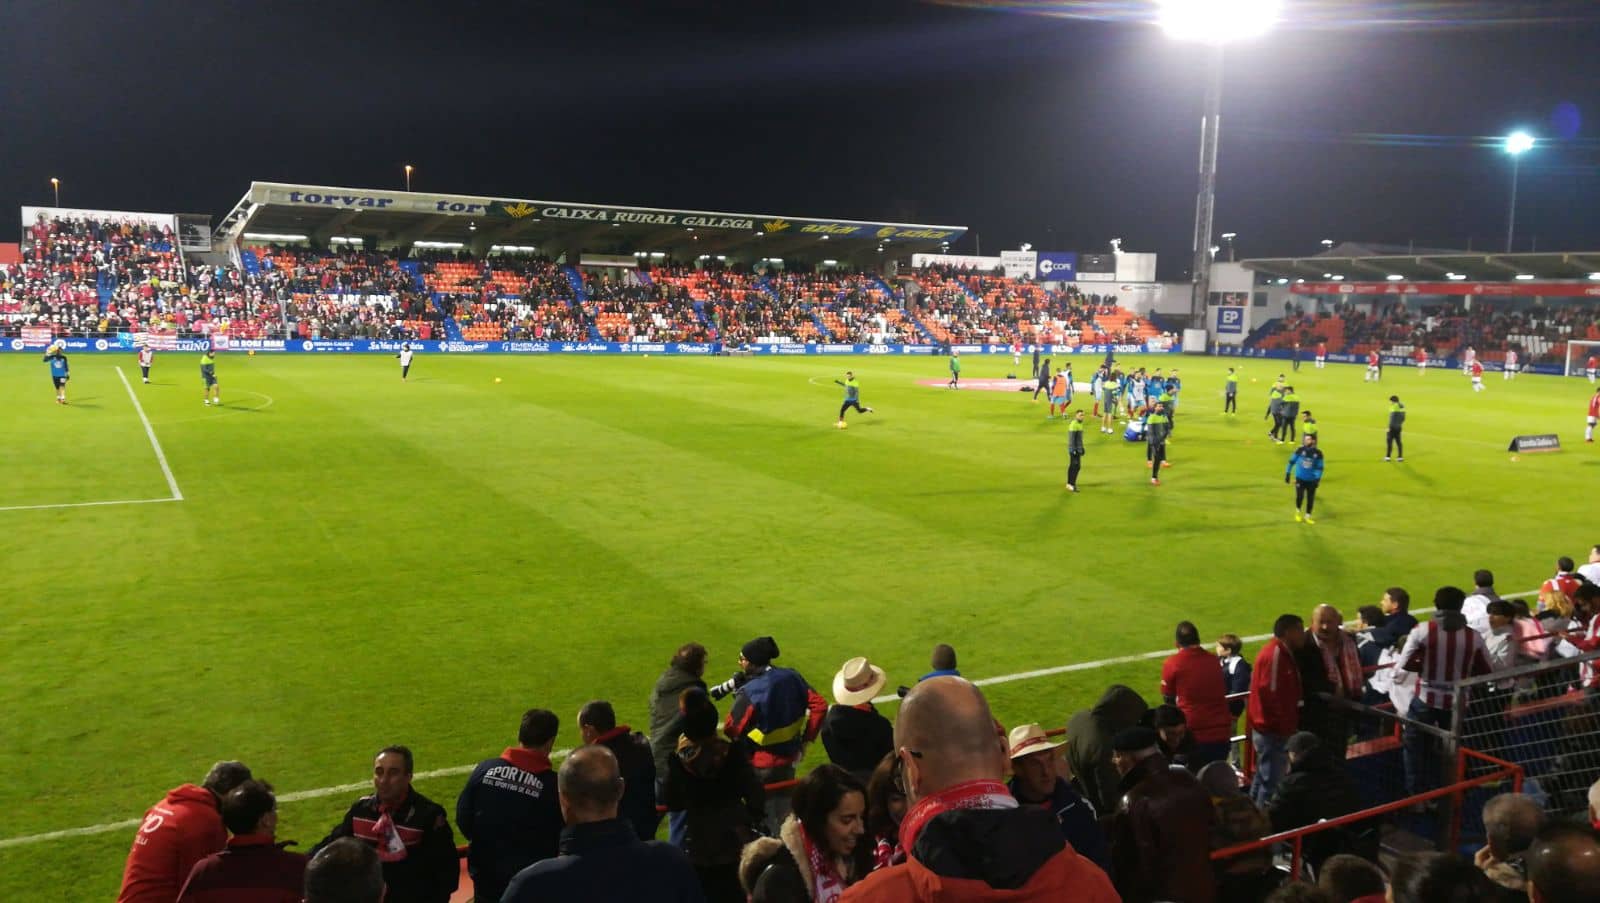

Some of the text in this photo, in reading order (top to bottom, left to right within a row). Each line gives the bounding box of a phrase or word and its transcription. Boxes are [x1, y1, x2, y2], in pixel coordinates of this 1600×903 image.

[288, 191, 393, 208] torvar
[436, 200, 486, 213] tor
[541, 207, 754, 229] CAIXA RURAL GALEGA
[1223, 311, 1239, 323] EP
[486, 766, 544, 790] SPORTING
